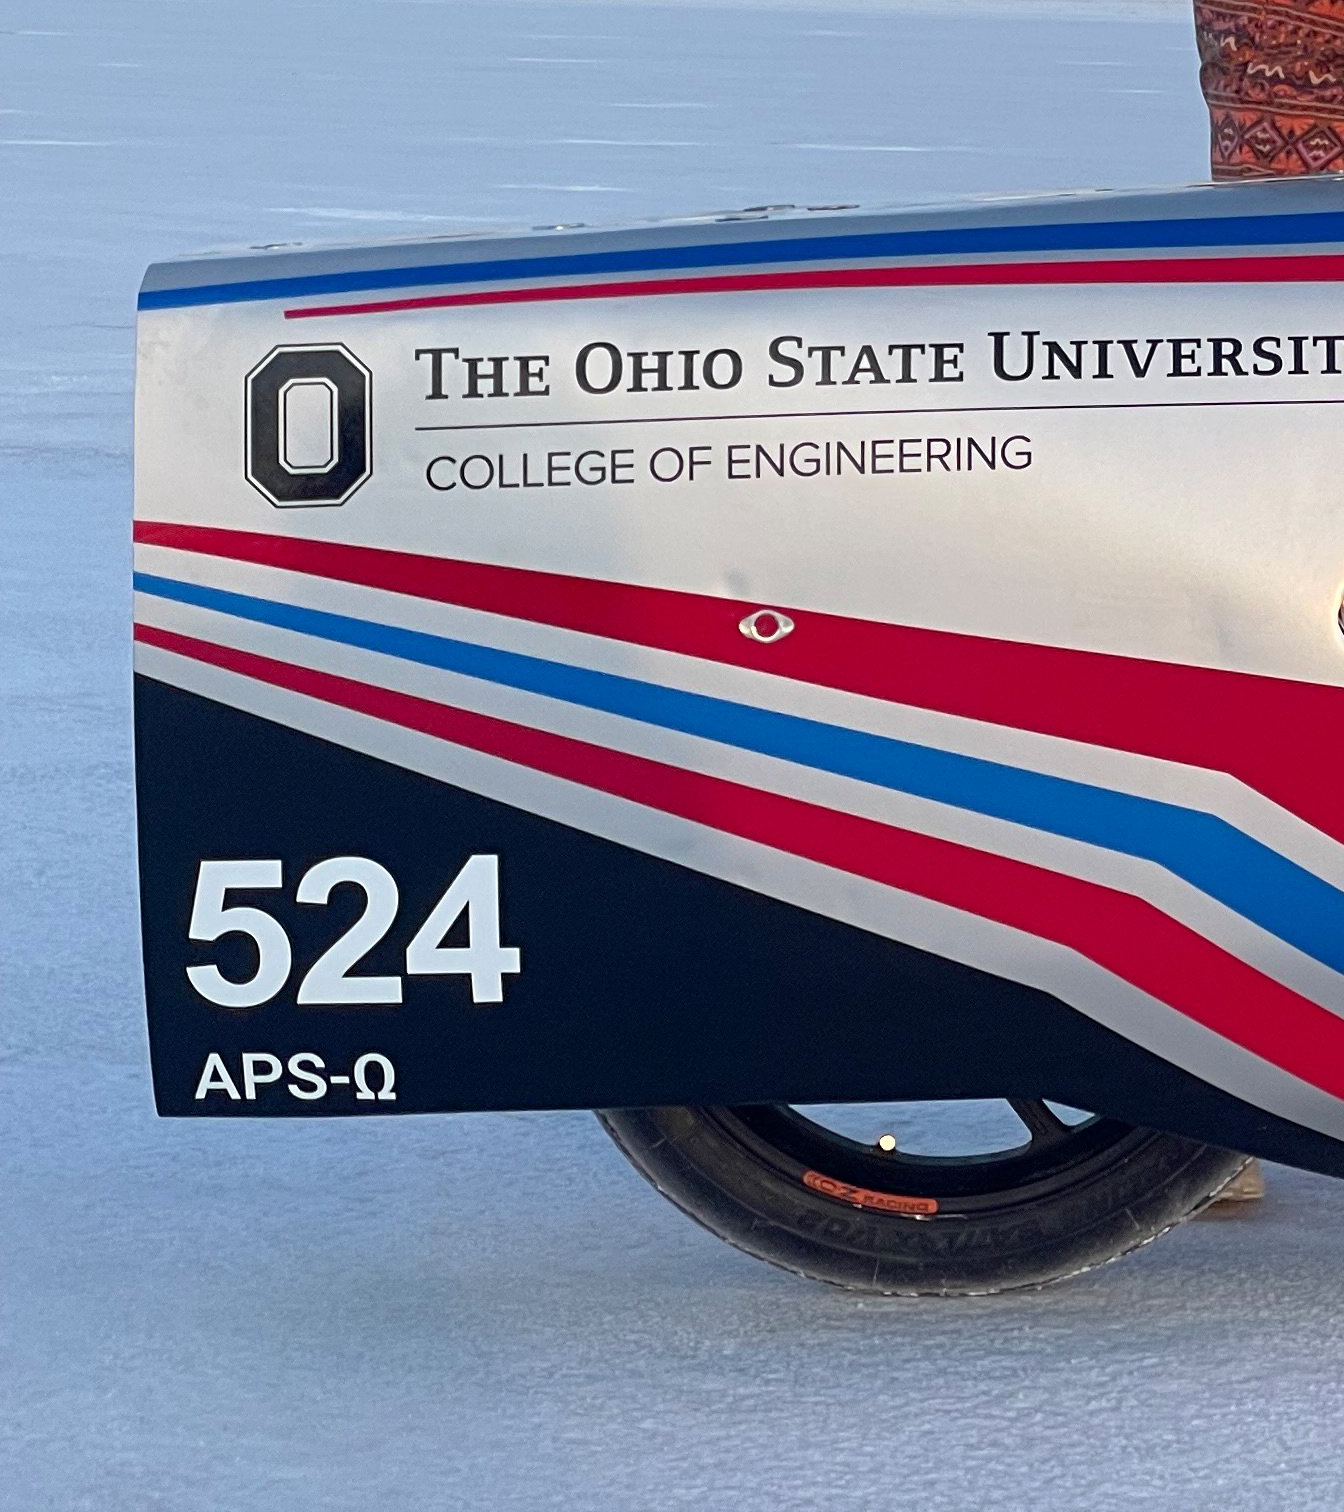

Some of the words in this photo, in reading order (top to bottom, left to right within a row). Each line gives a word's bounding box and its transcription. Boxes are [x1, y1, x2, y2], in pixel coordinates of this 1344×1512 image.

[425, 448, 634, 491] COLLEGE
[650, 445, 712, 482] OF
[727, 435, 1032, 480] ENGINEERING
[186, 854, 521, 1007] 524
